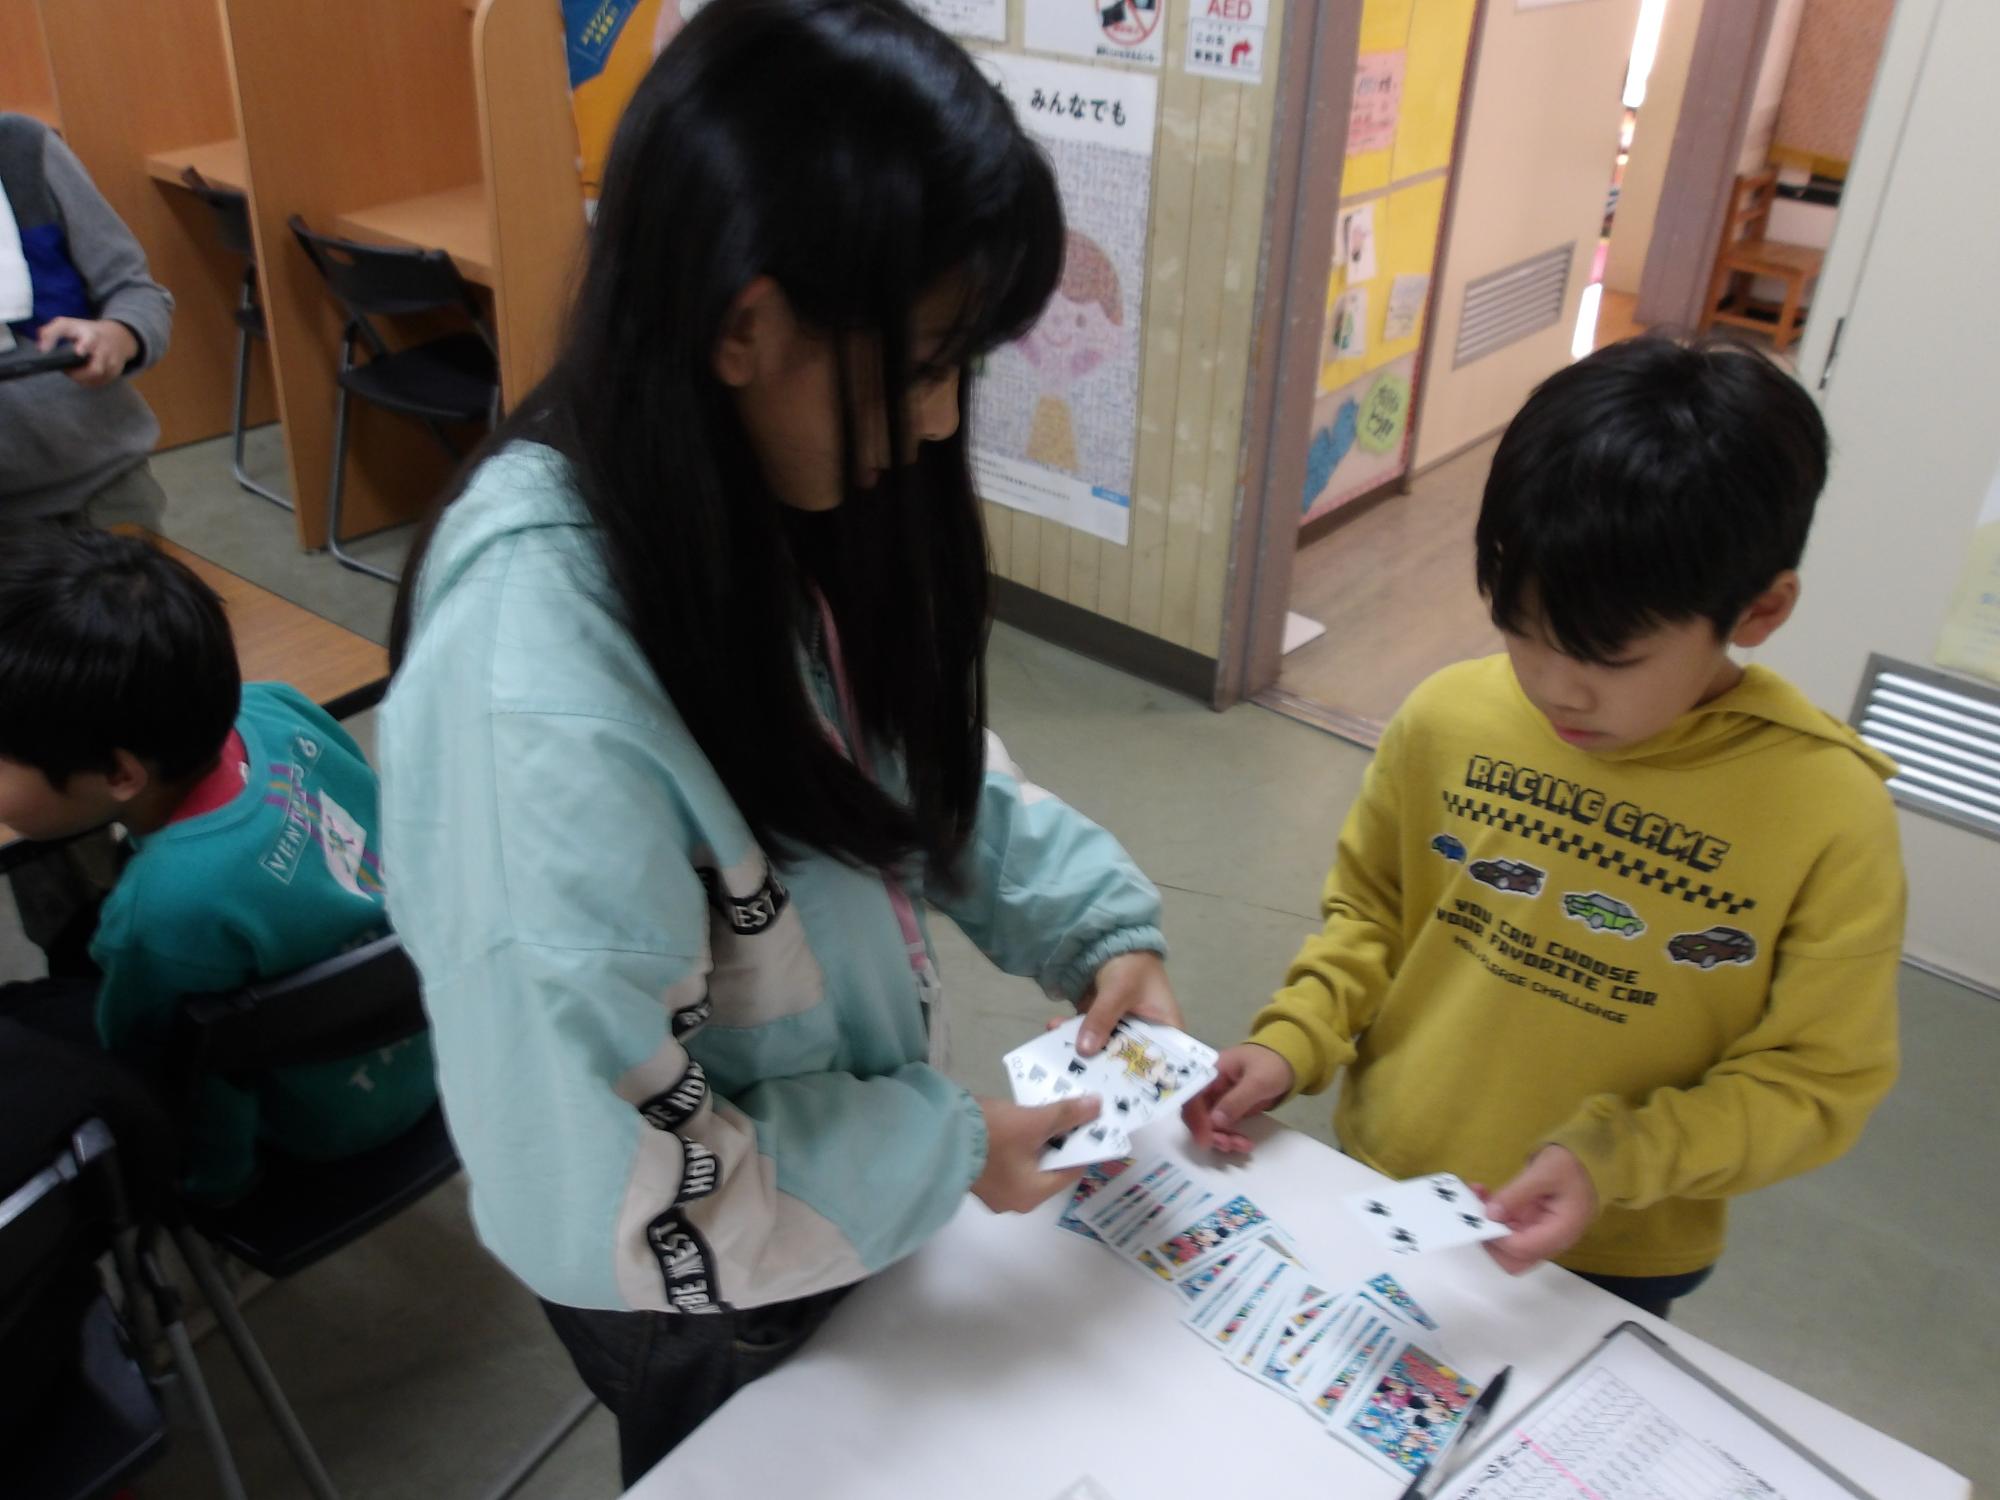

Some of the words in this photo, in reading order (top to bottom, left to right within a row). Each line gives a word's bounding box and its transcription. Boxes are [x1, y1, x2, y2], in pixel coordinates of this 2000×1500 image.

[1031, 88, 1126, 127] みんなでも
[1465, 755, 1606, 825] RACING
[1604, 801, 1731, 872] GAME
[1436, 907, 1484, 937] YOUR
[1489, 934, 1600, 992] FAVORITE
[1610, 985, 1658, 1007] CAR
[1453, 898, 1492, 922] YOU
[1500, 921, 1537, 948] CAN
[1546, 941, 1640, 985] CHOOSE
[1531, 981, 1628, 1024] CHALLENGE
